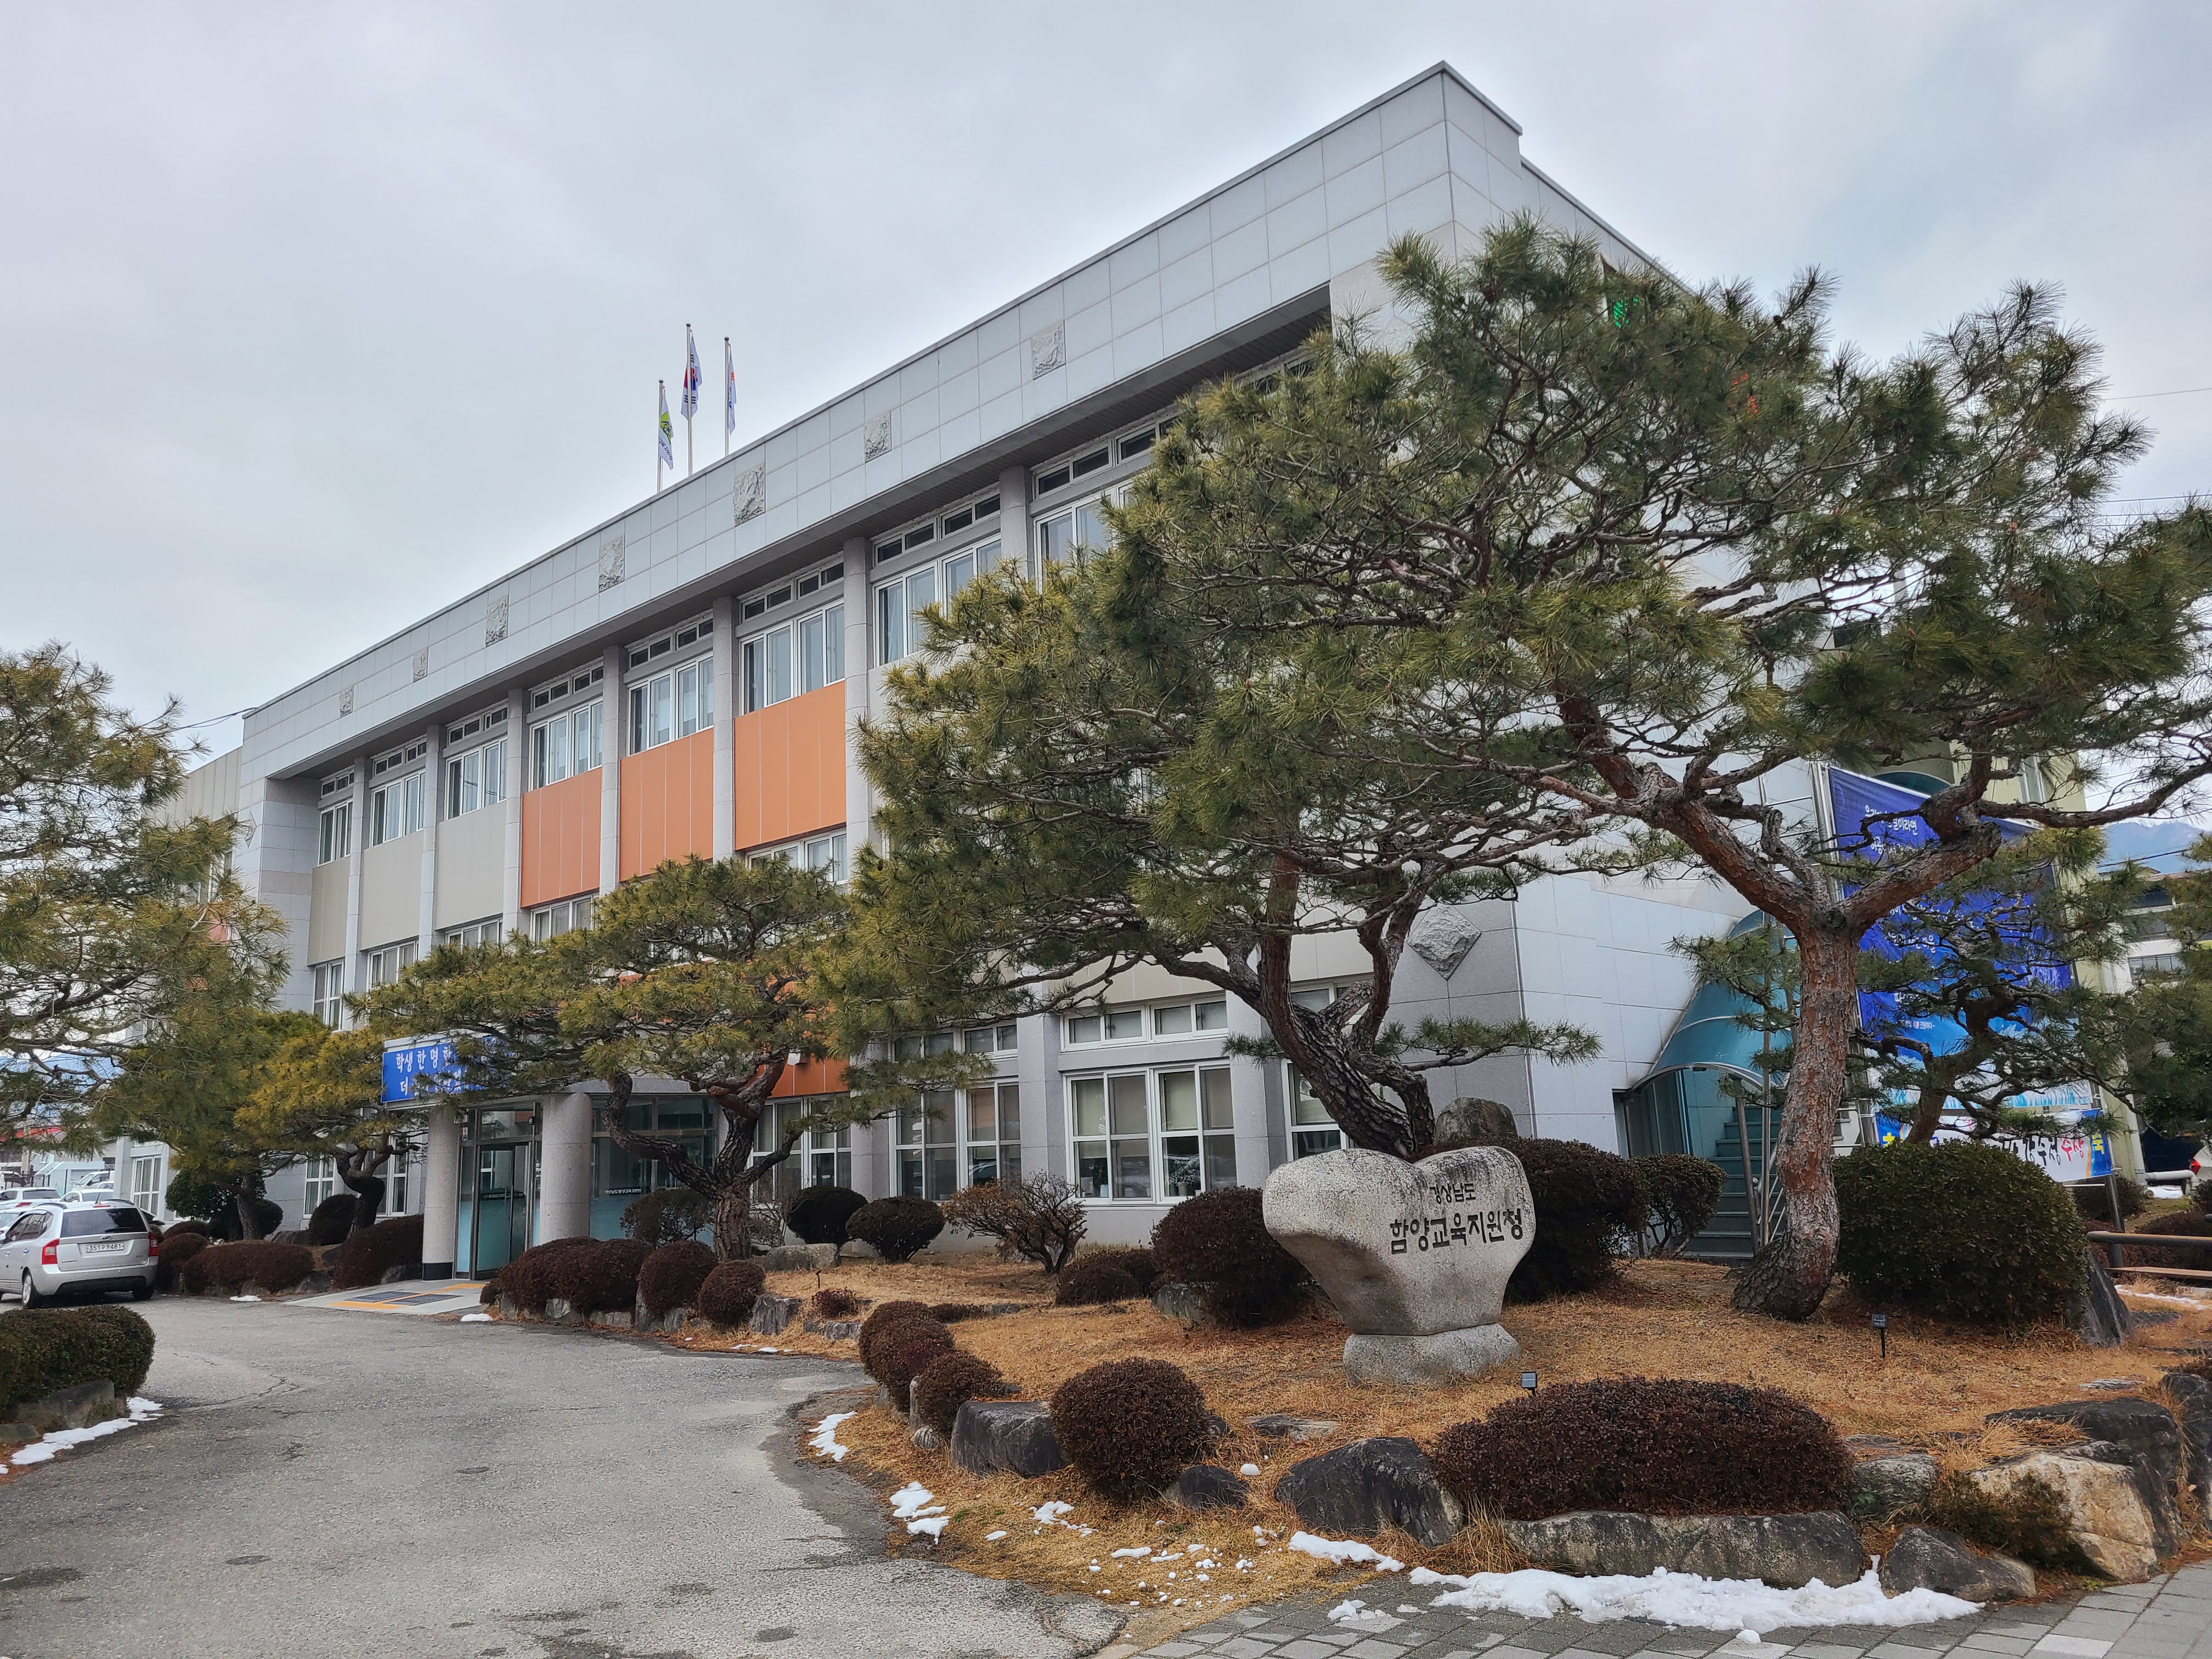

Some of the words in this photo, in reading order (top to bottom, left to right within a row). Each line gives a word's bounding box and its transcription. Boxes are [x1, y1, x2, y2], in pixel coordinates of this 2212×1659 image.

[396, 1051, 413, 1074] 학생
[416, 1049, 426, 1070] 한
[430, 1046, 438, 1069] 명
[400, 1076, 408, 1096] 더
[2061, 1133, 2084, 1163] 수상
[1429, 1182, 1476, 1204] 경상남도
[1389, 1208, 1523, 1255] 함양교육지원청
